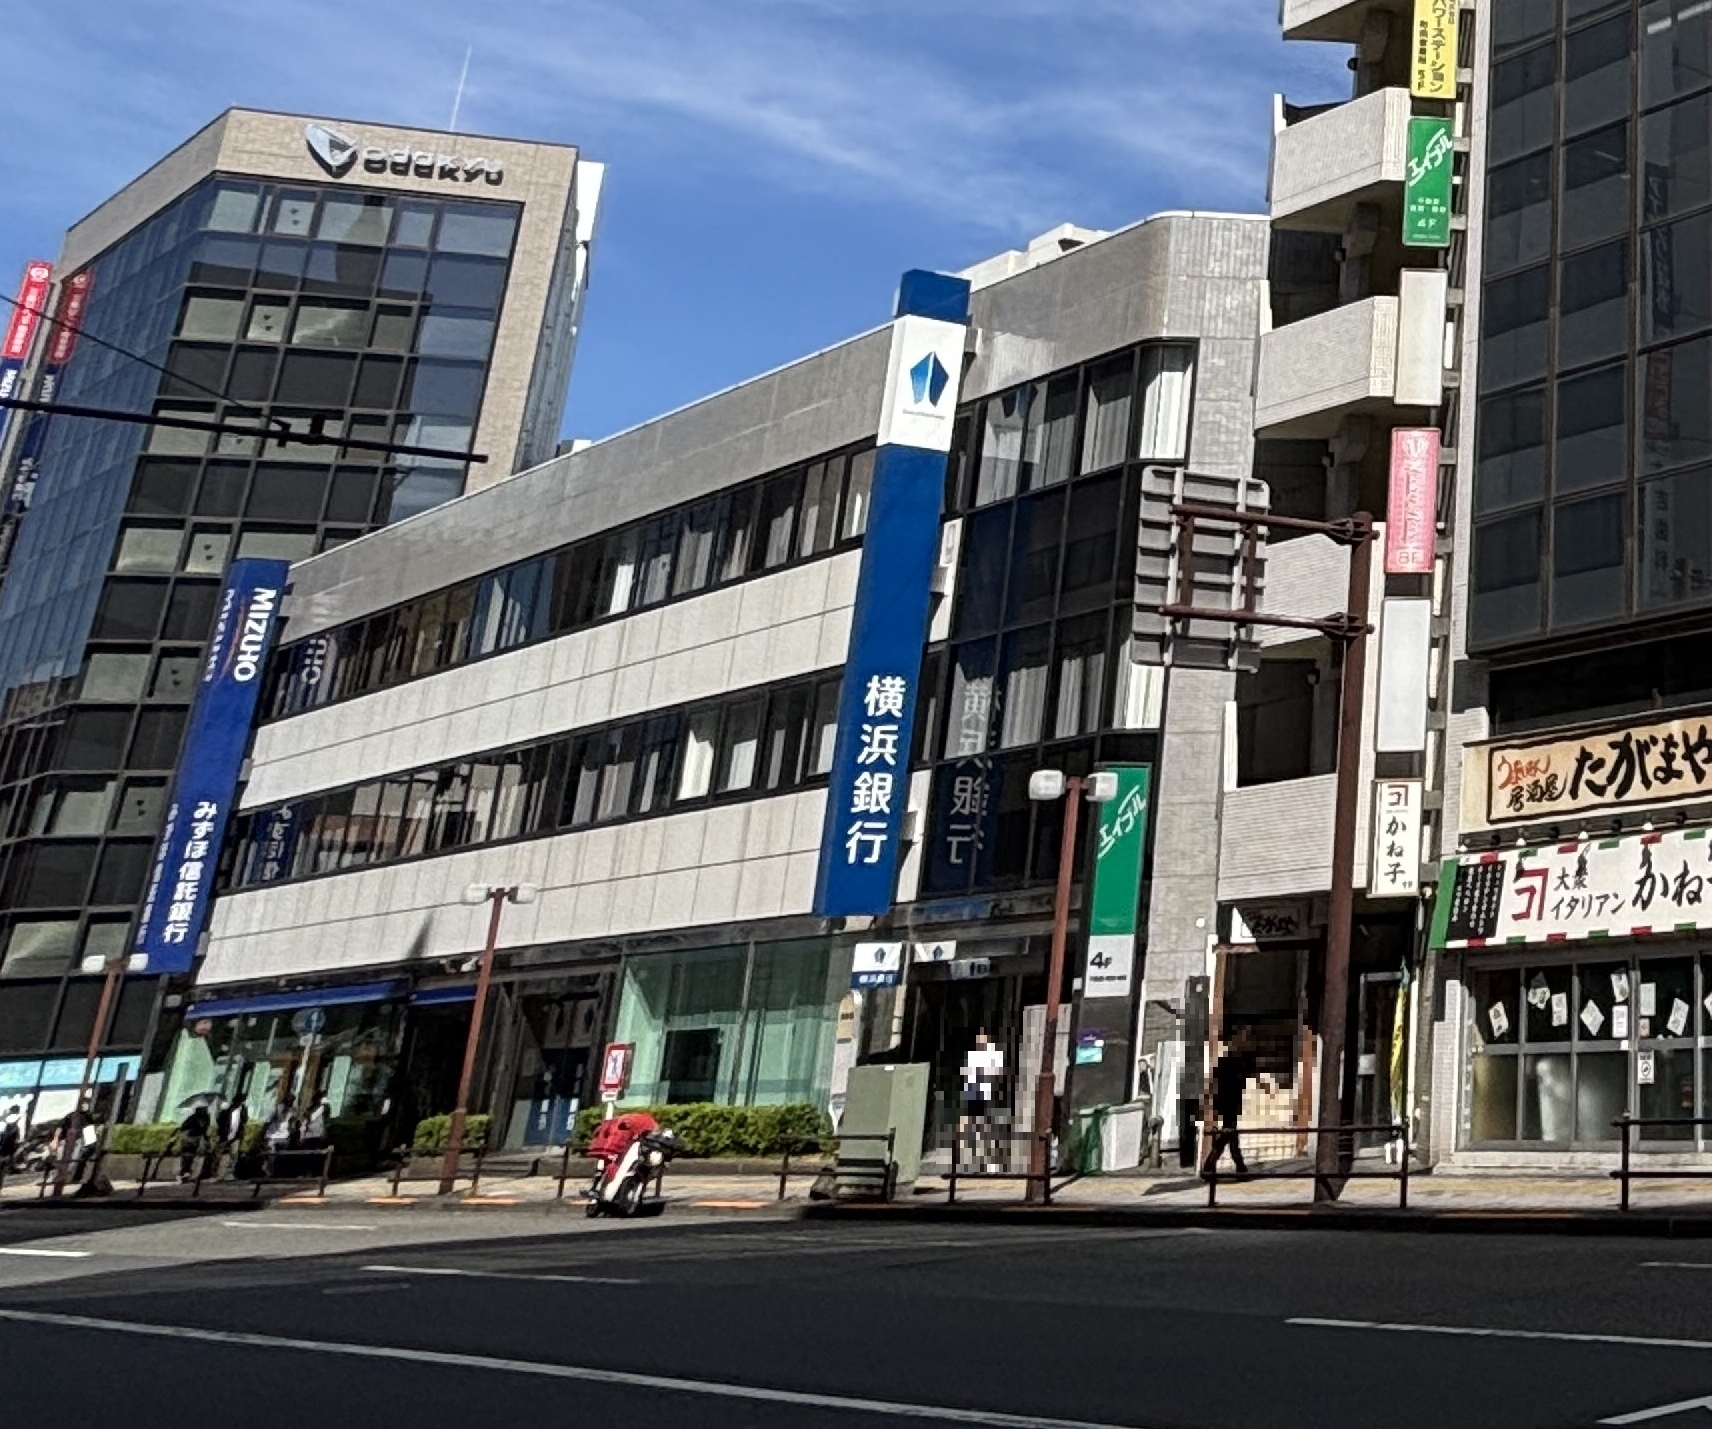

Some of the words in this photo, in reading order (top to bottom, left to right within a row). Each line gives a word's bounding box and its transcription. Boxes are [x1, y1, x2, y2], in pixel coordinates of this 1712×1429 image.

[363, 145, 504, 181] odakyu
[1408, 127, 1454, 187] エイブル
[234, 586, 277, 683] MIZUHO
[846, 675, 906, 864] 横浜銀行
[1506, 772, 1568, 812] 居酒屋
[1098, 786, 1147, 858] エイブル
[1384, 815, 1407, 884] かね子
[163, 801, 218, 944] みずほ信託銀行
[1551, 892, 1625, 920] イタリアン
[1089, 951, 1113, 969] 4F
